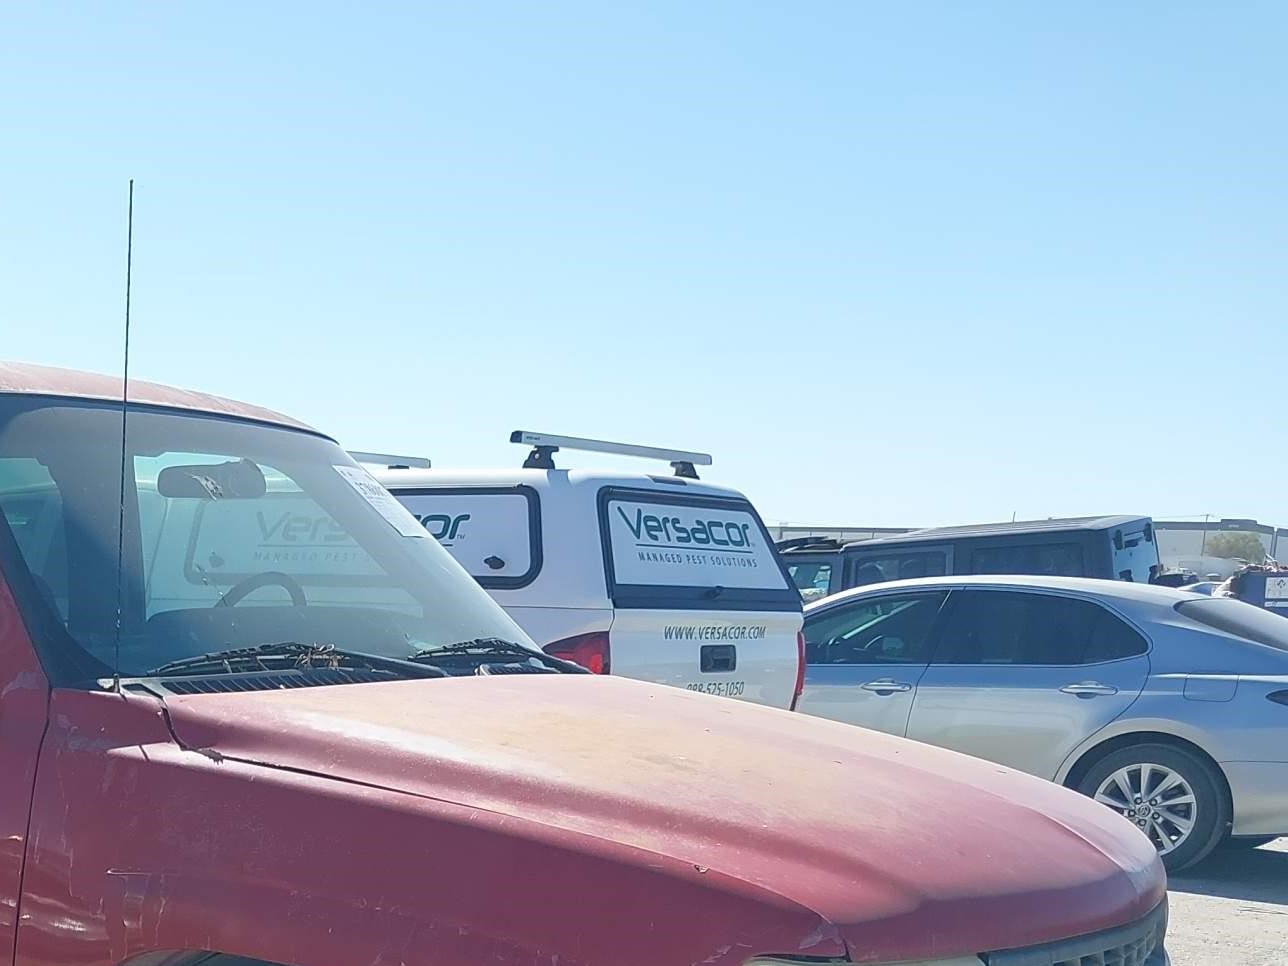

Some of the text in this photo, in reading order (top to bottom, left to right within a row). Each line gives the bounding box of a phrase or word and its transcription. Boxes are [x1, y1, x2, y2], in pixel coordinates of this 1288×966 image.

[616, 505, 750, 548] Versacor
[637, 551, 758, 568] MANAGED PEST SOLUTIONS
[663, 624, 767, 641] WWW.VERSACOR.COM
